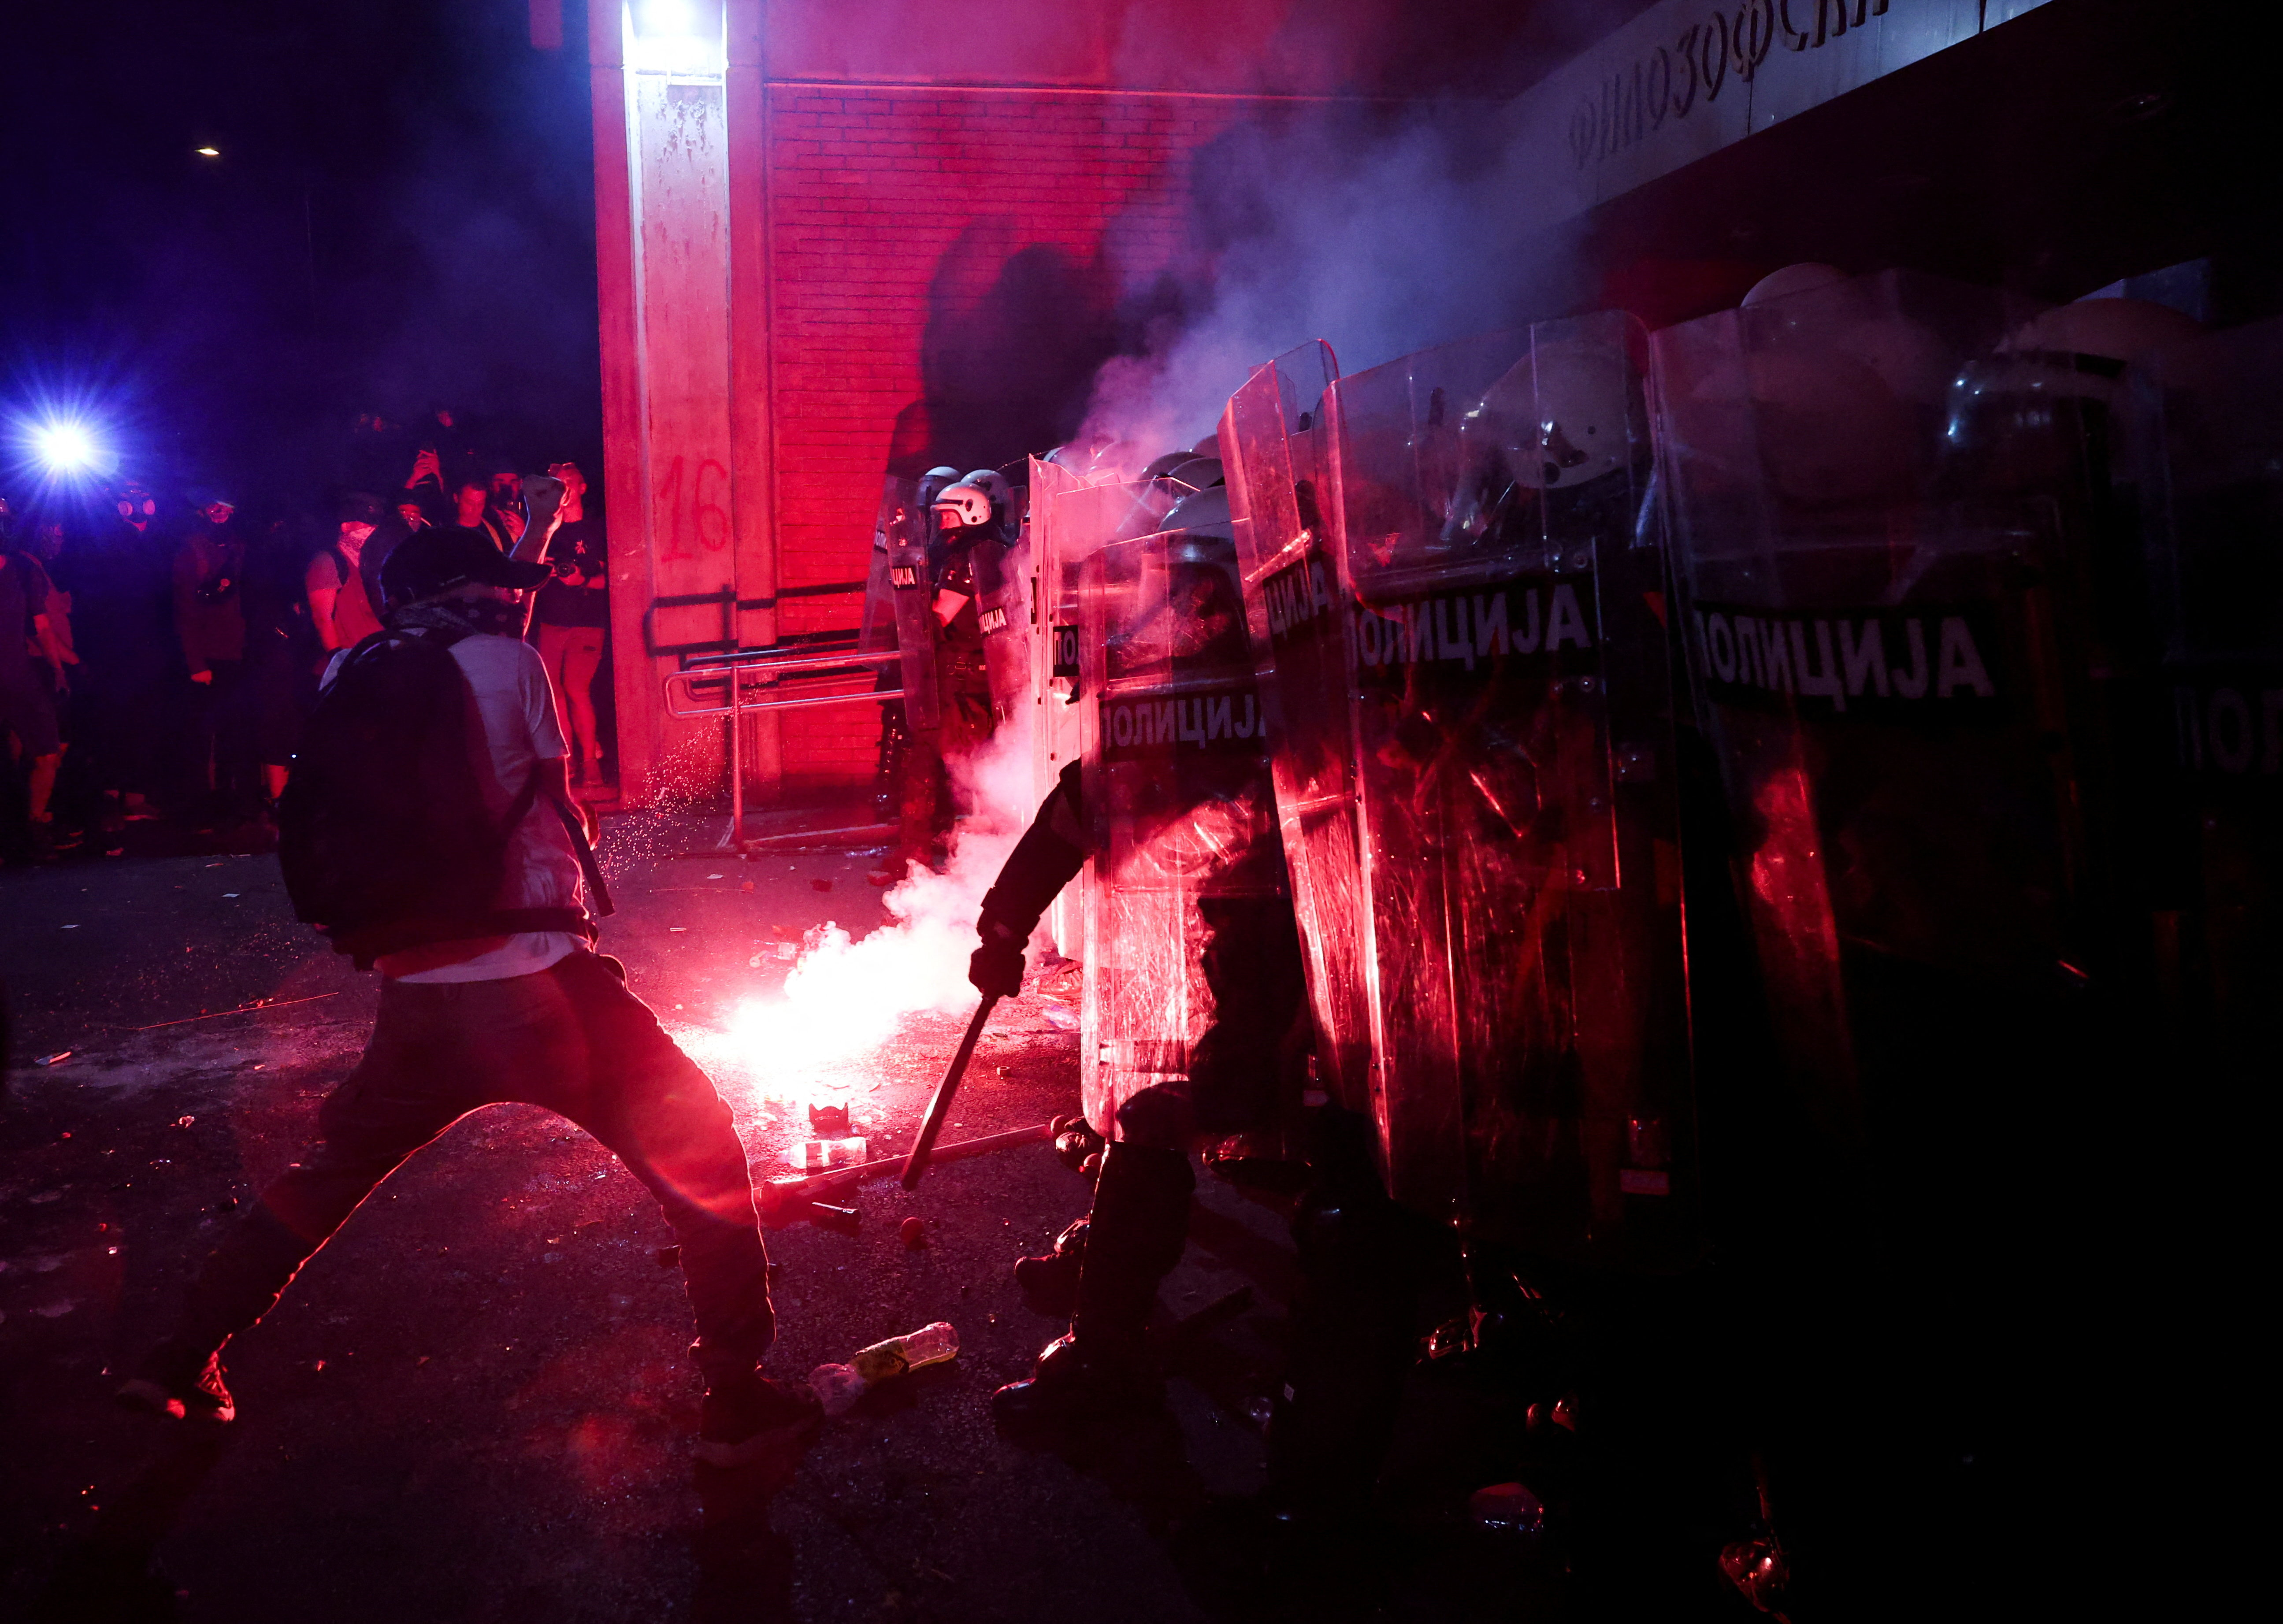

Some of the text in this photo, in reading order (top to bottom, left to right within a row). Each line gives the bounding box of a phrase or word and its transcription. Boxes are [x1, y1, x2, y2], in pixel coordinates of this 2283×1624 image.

[1569, 0, 1889, 171] ФИЛОЗОФС
[661, 455, 728, 562] 16
[1101, 694, 1266, 749] ПОЛИЦИЈ
